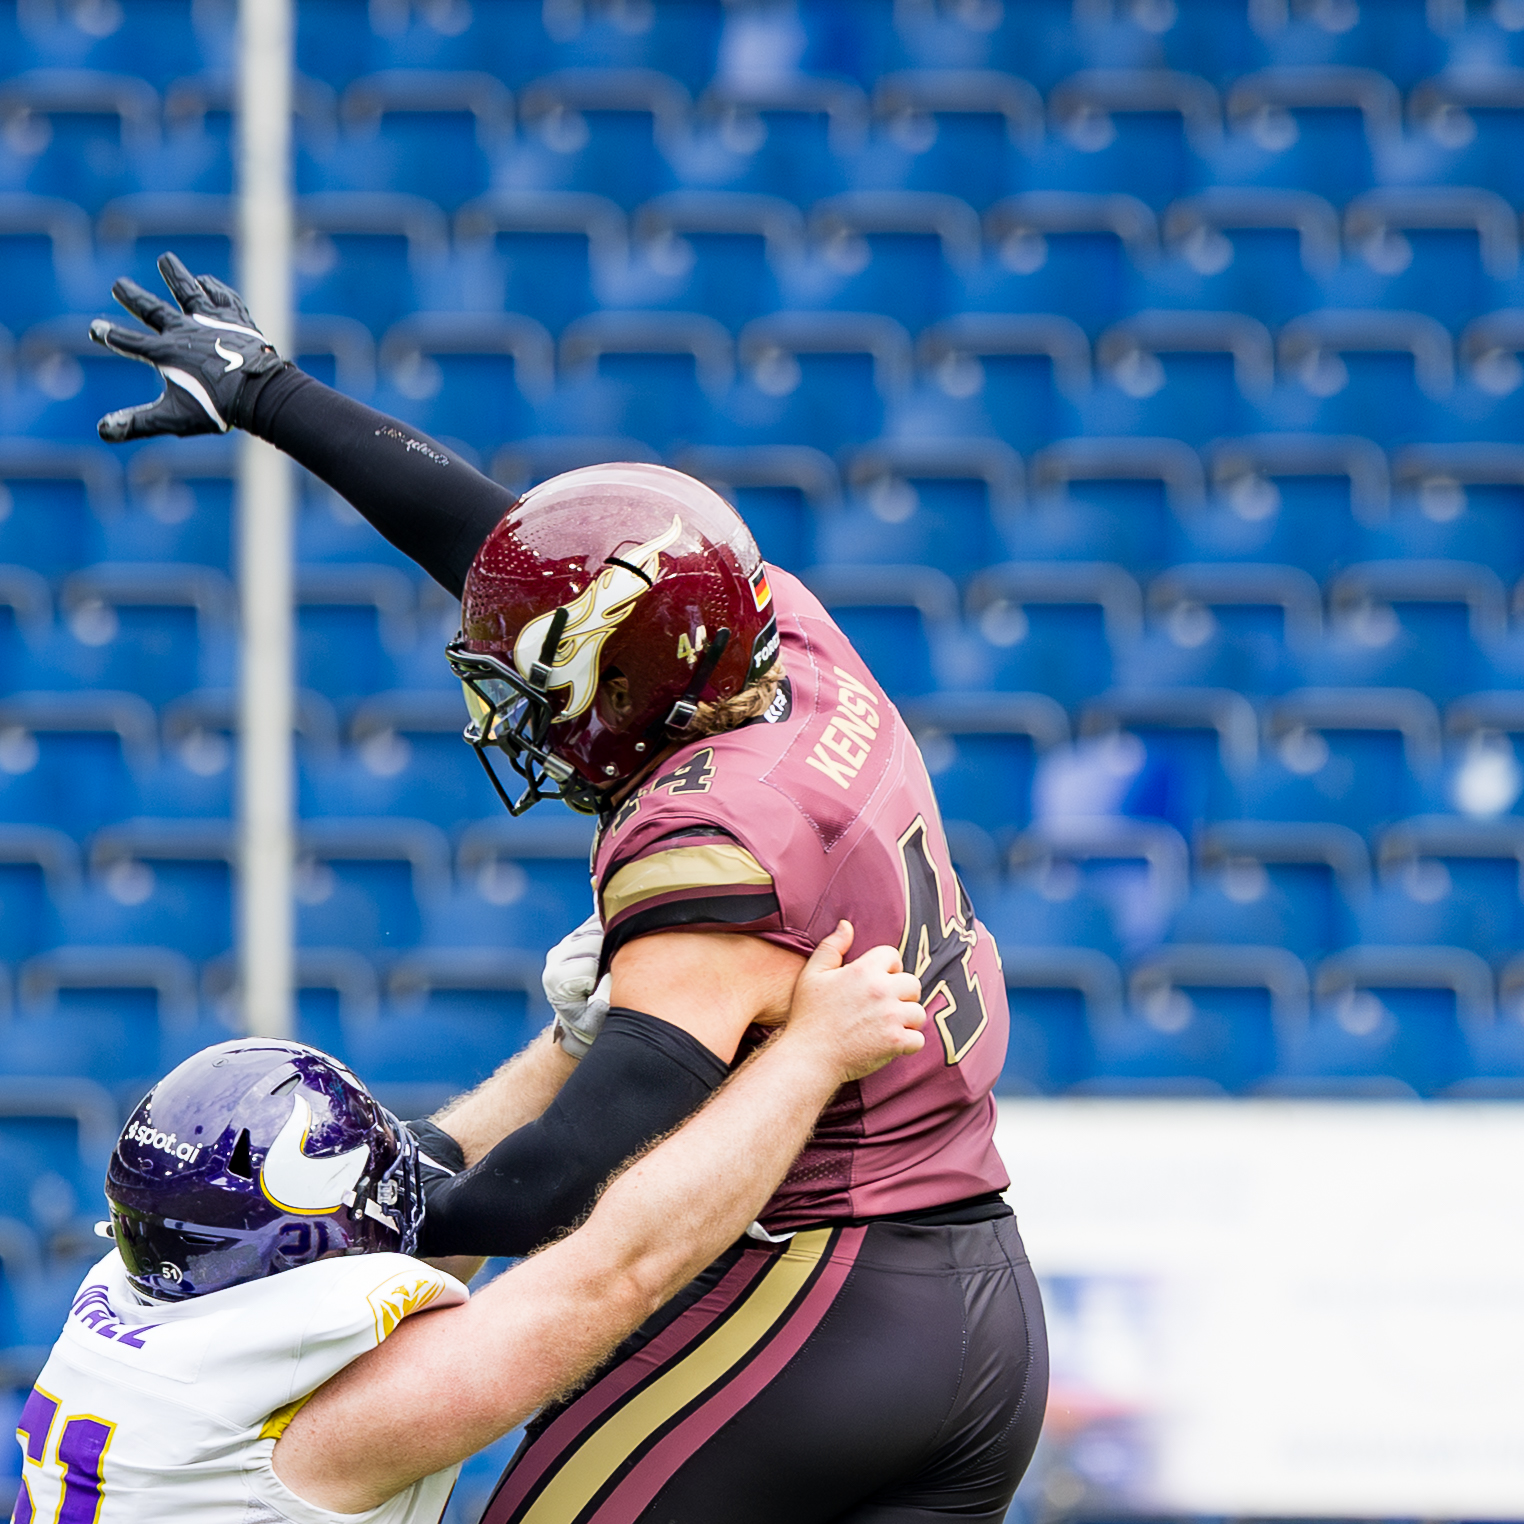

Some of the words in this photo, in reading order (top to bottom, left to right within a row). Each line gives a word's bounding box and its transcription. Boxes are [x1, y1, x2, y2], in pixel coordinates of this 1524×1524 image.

[805, 665, 880, 790] KENSY
[896, 812, 1002, 1068] 4
[134, 1125, 203, 1164] spot.ai
[162, 1267, 178, 1280] 51
